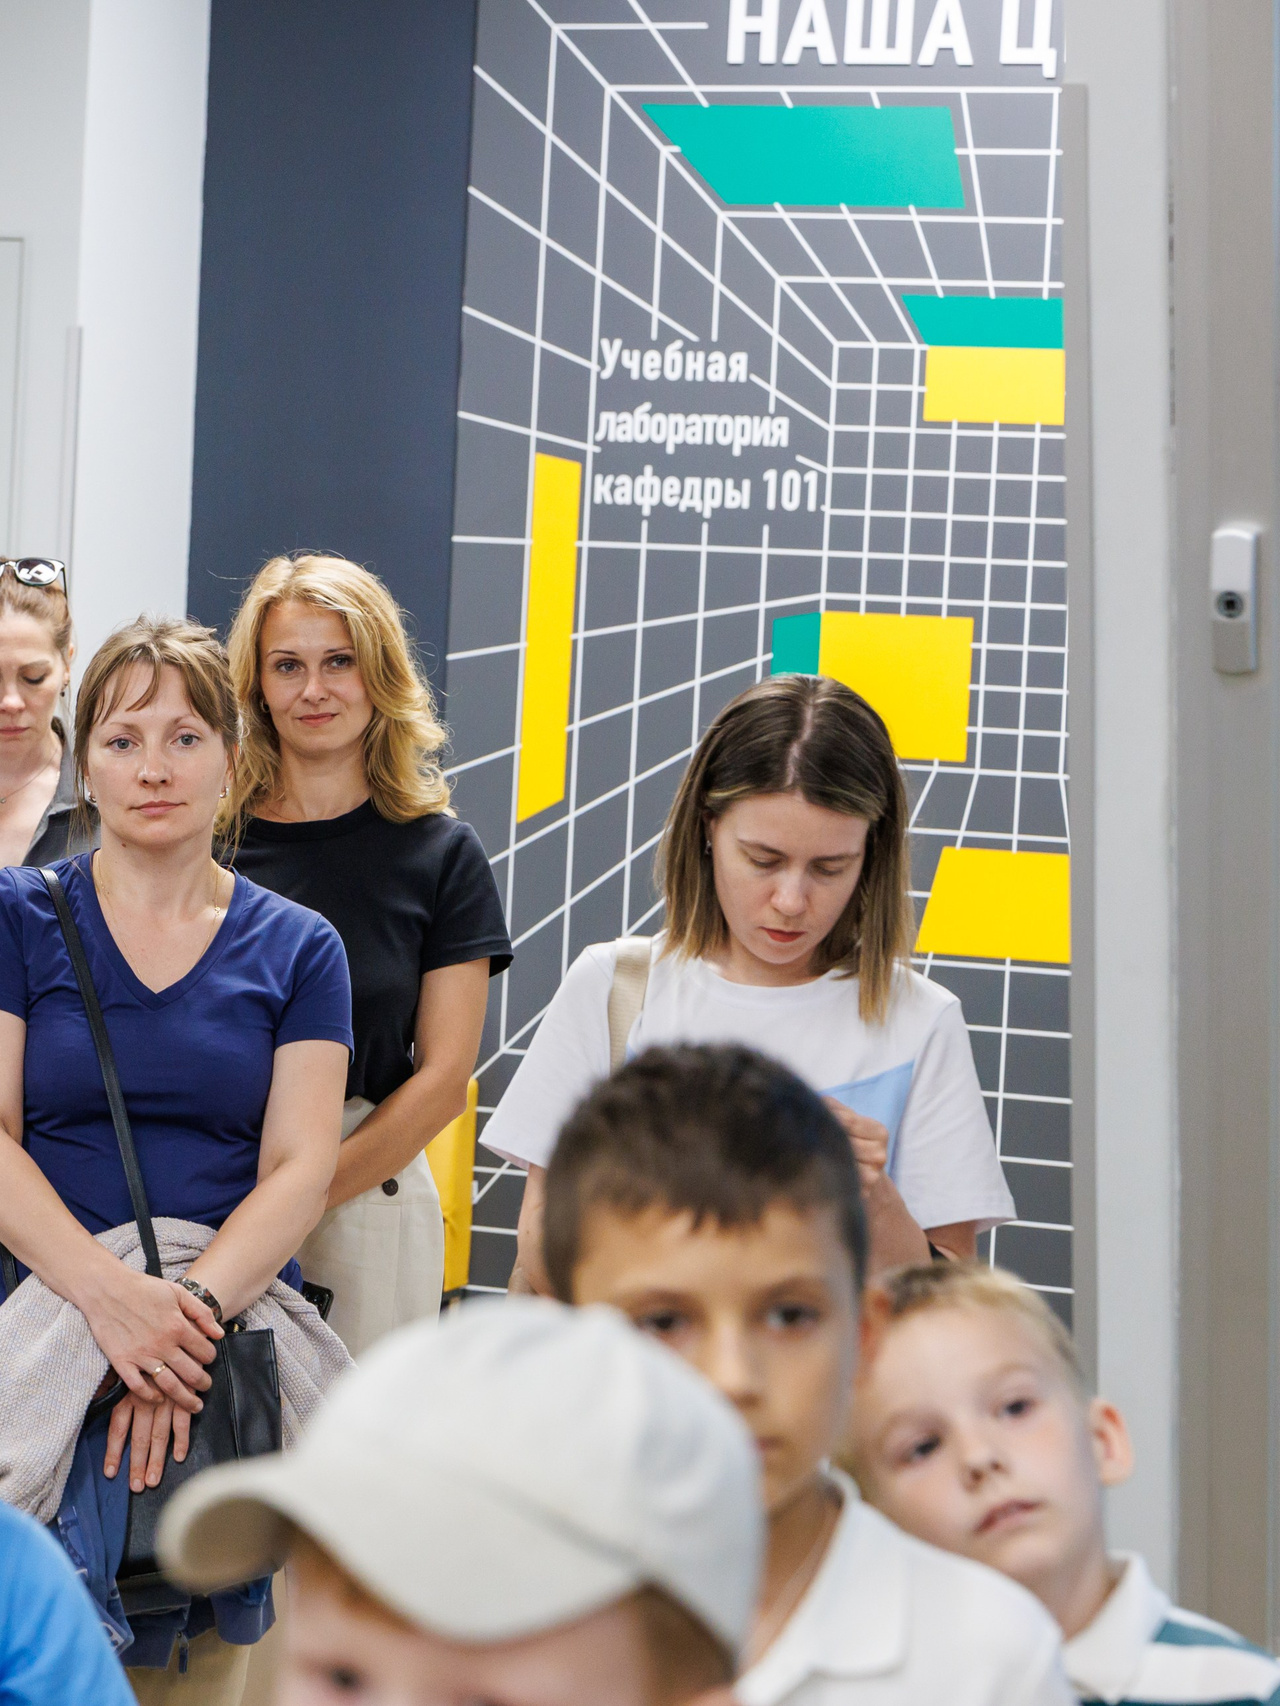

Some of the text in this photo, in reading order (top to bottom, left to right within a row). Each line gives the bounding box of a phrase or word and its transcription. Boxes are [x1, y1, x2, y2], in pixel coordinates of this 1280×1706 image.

[726, 0, 1066, 79] НАША Ц
[599, 337, 749, 383] Учебная
[594, 401, 790, 457] лаборатория
[593, 464, 818, 519] кафедры 101
